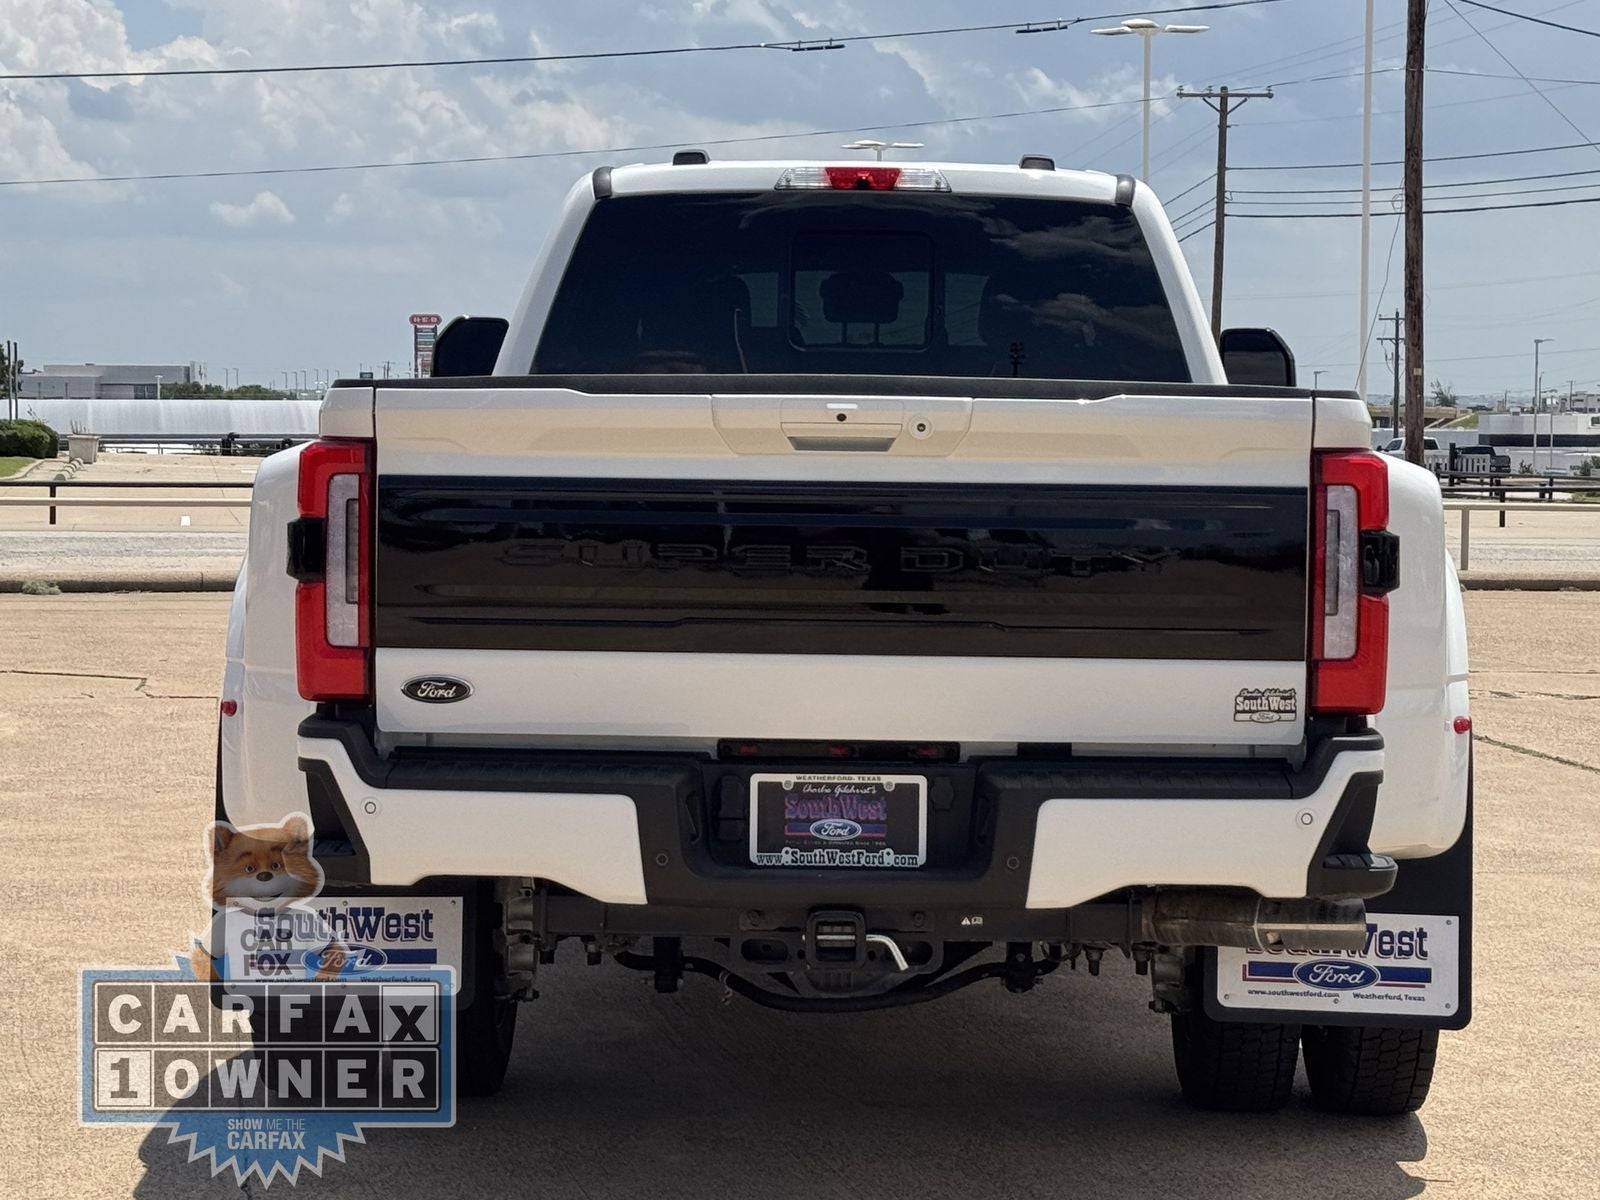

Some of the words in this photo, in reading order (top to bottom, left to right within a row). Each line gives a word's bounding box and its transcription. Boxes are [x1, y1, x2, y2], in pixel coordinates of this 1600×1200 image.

[416, 680, 457, 698] Ford
[1236, 696, 1296, 710] SouthWest
[784, 796, 887, 820] SouthWest
[820, 823, 850, 836] Ford
[255, 907, 433, 942] SouthWest
[317, 951, 371, 969] Ford
[1308, 963, 1365, 985] Ford
